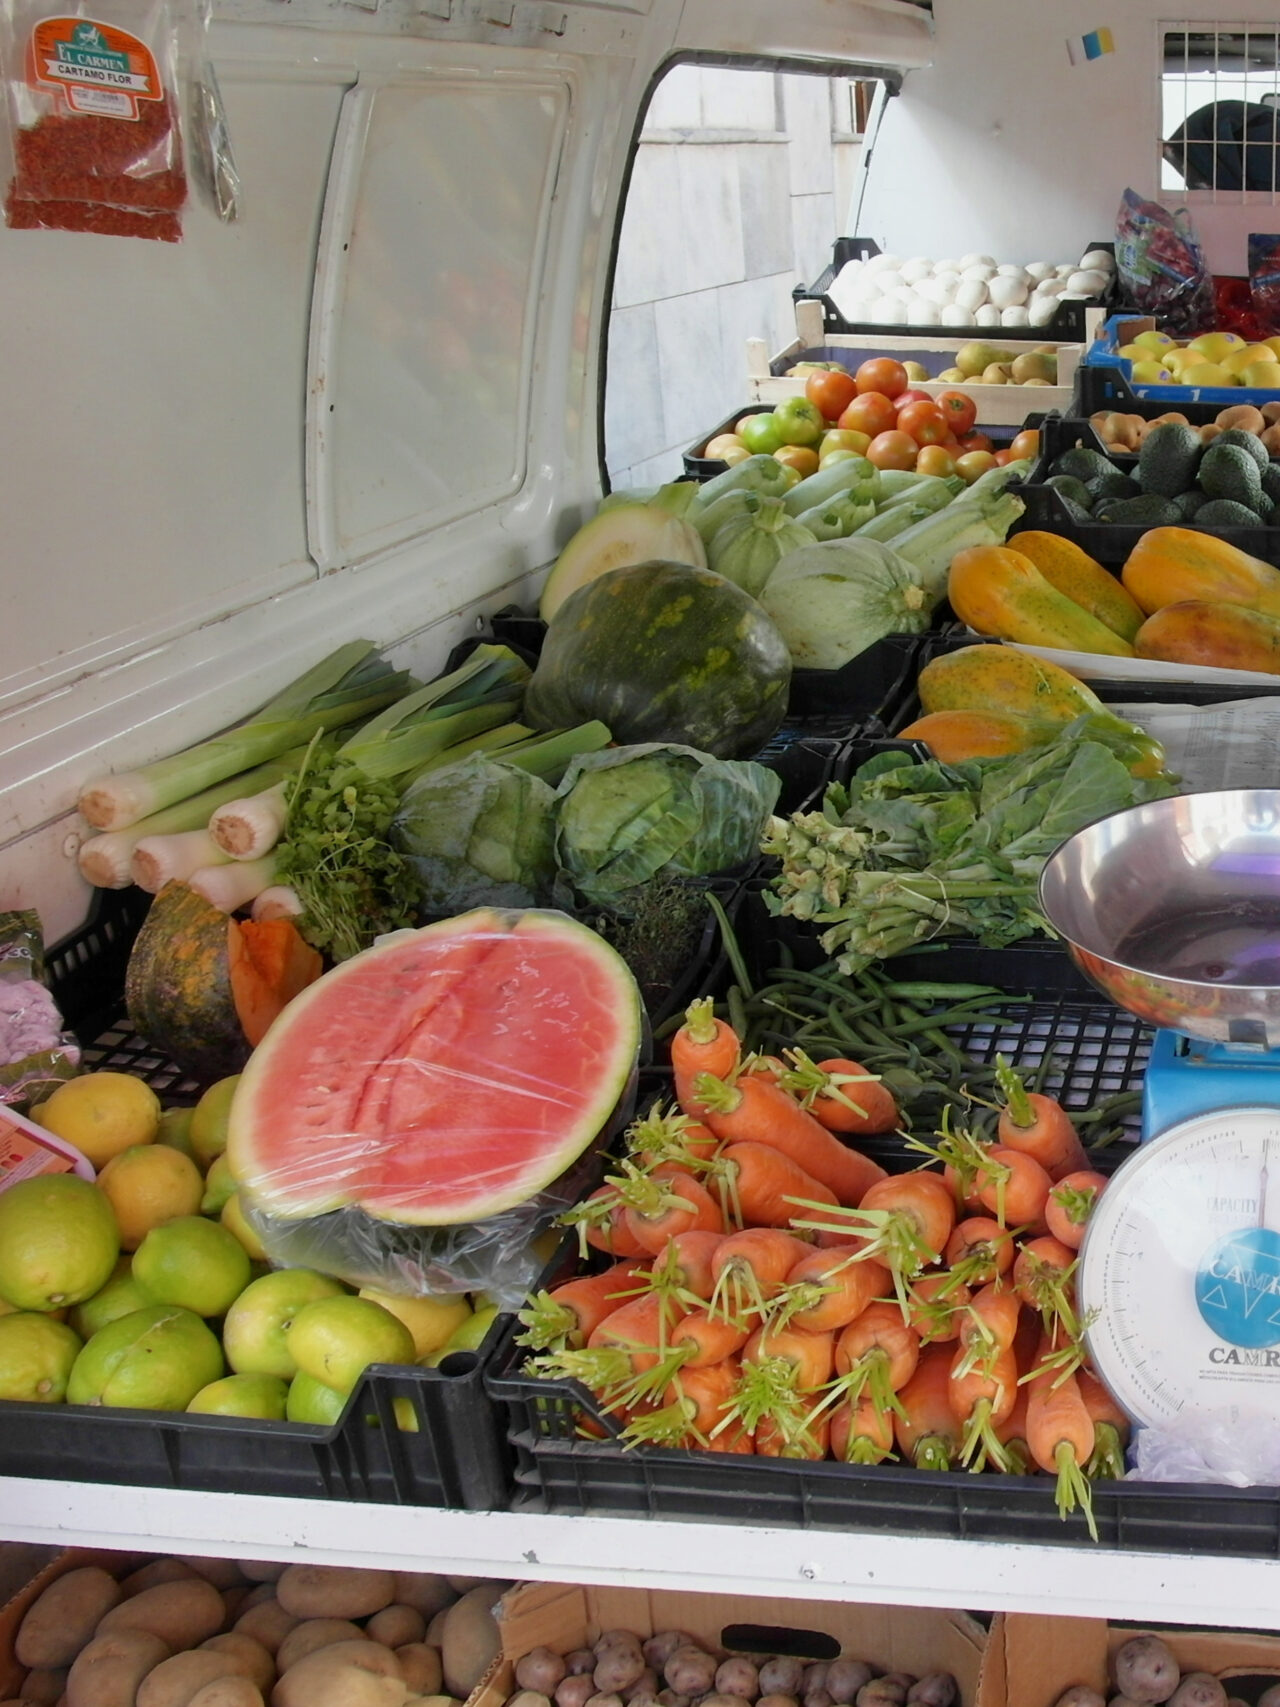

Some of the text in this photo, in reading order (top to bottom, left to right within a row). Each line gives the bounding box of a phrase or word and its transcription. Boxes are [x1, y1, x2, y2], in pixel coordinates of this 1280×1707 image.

[77, 53, 125, 70] CARMEN
[58, 64, 133, 84] CARTAMO FLOR
